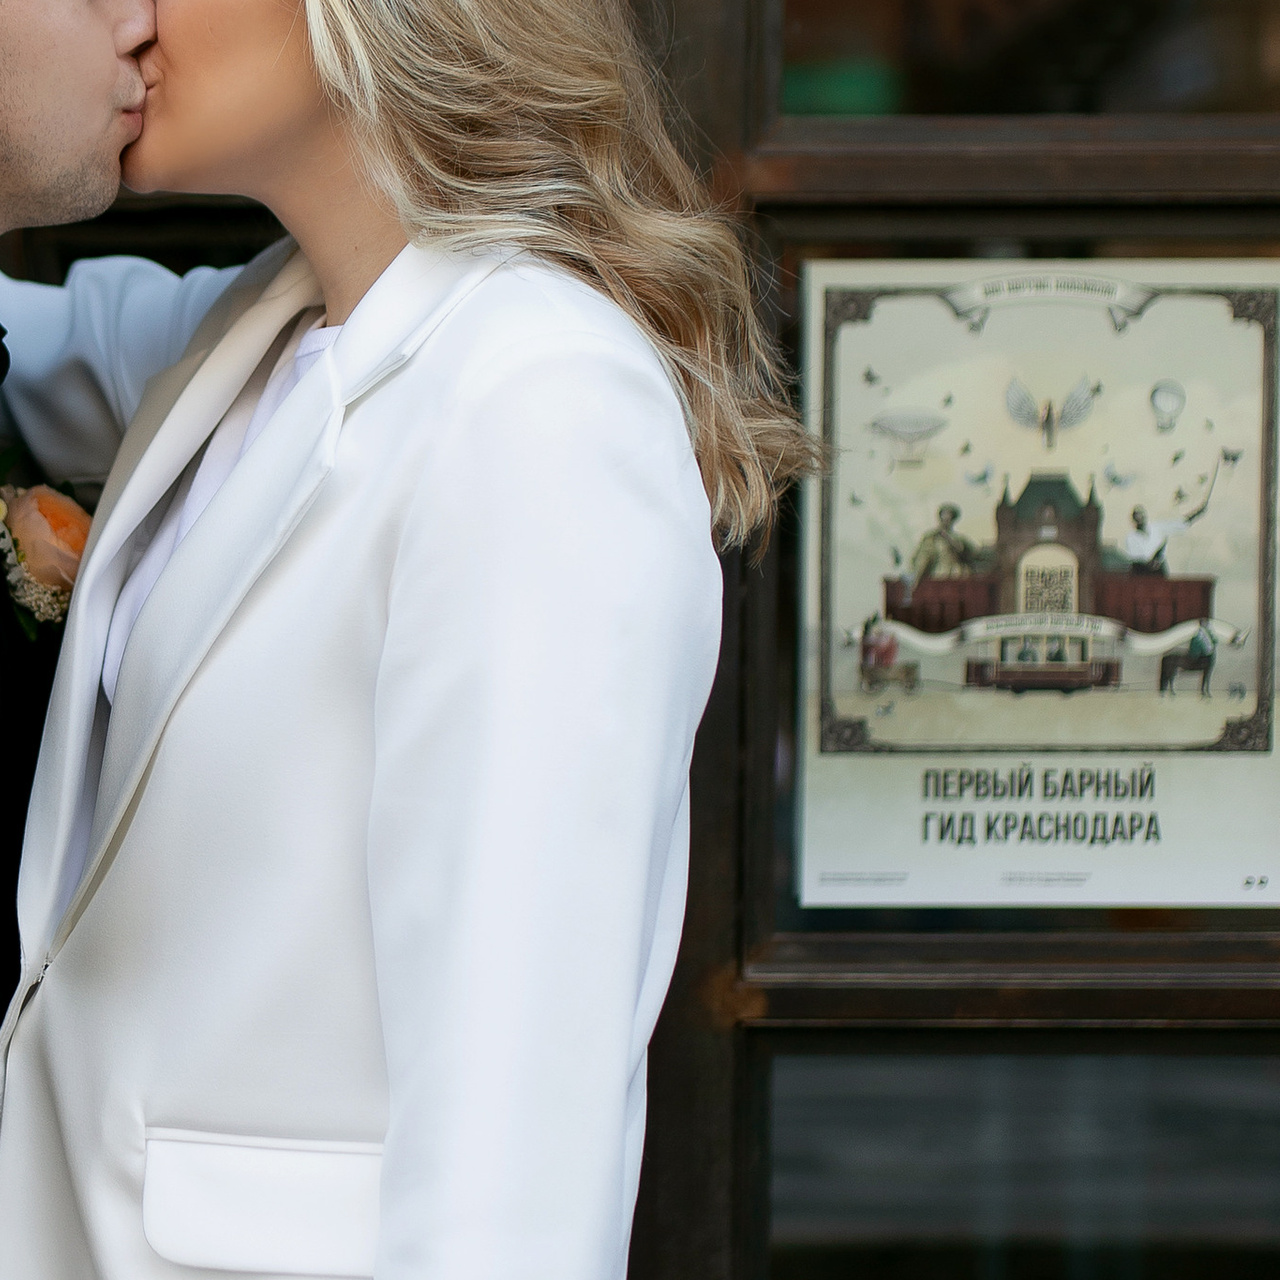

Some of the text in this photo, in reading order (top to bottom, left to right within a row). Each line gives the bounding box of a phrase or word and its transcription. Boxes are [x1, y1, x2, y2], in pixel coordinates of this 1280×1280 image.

[922, 761, 1156, 801] ПЕРВЫЙ БАРНЫЙ
[922, 811, 1161, 846] ГИД КРАСНОДАРА
